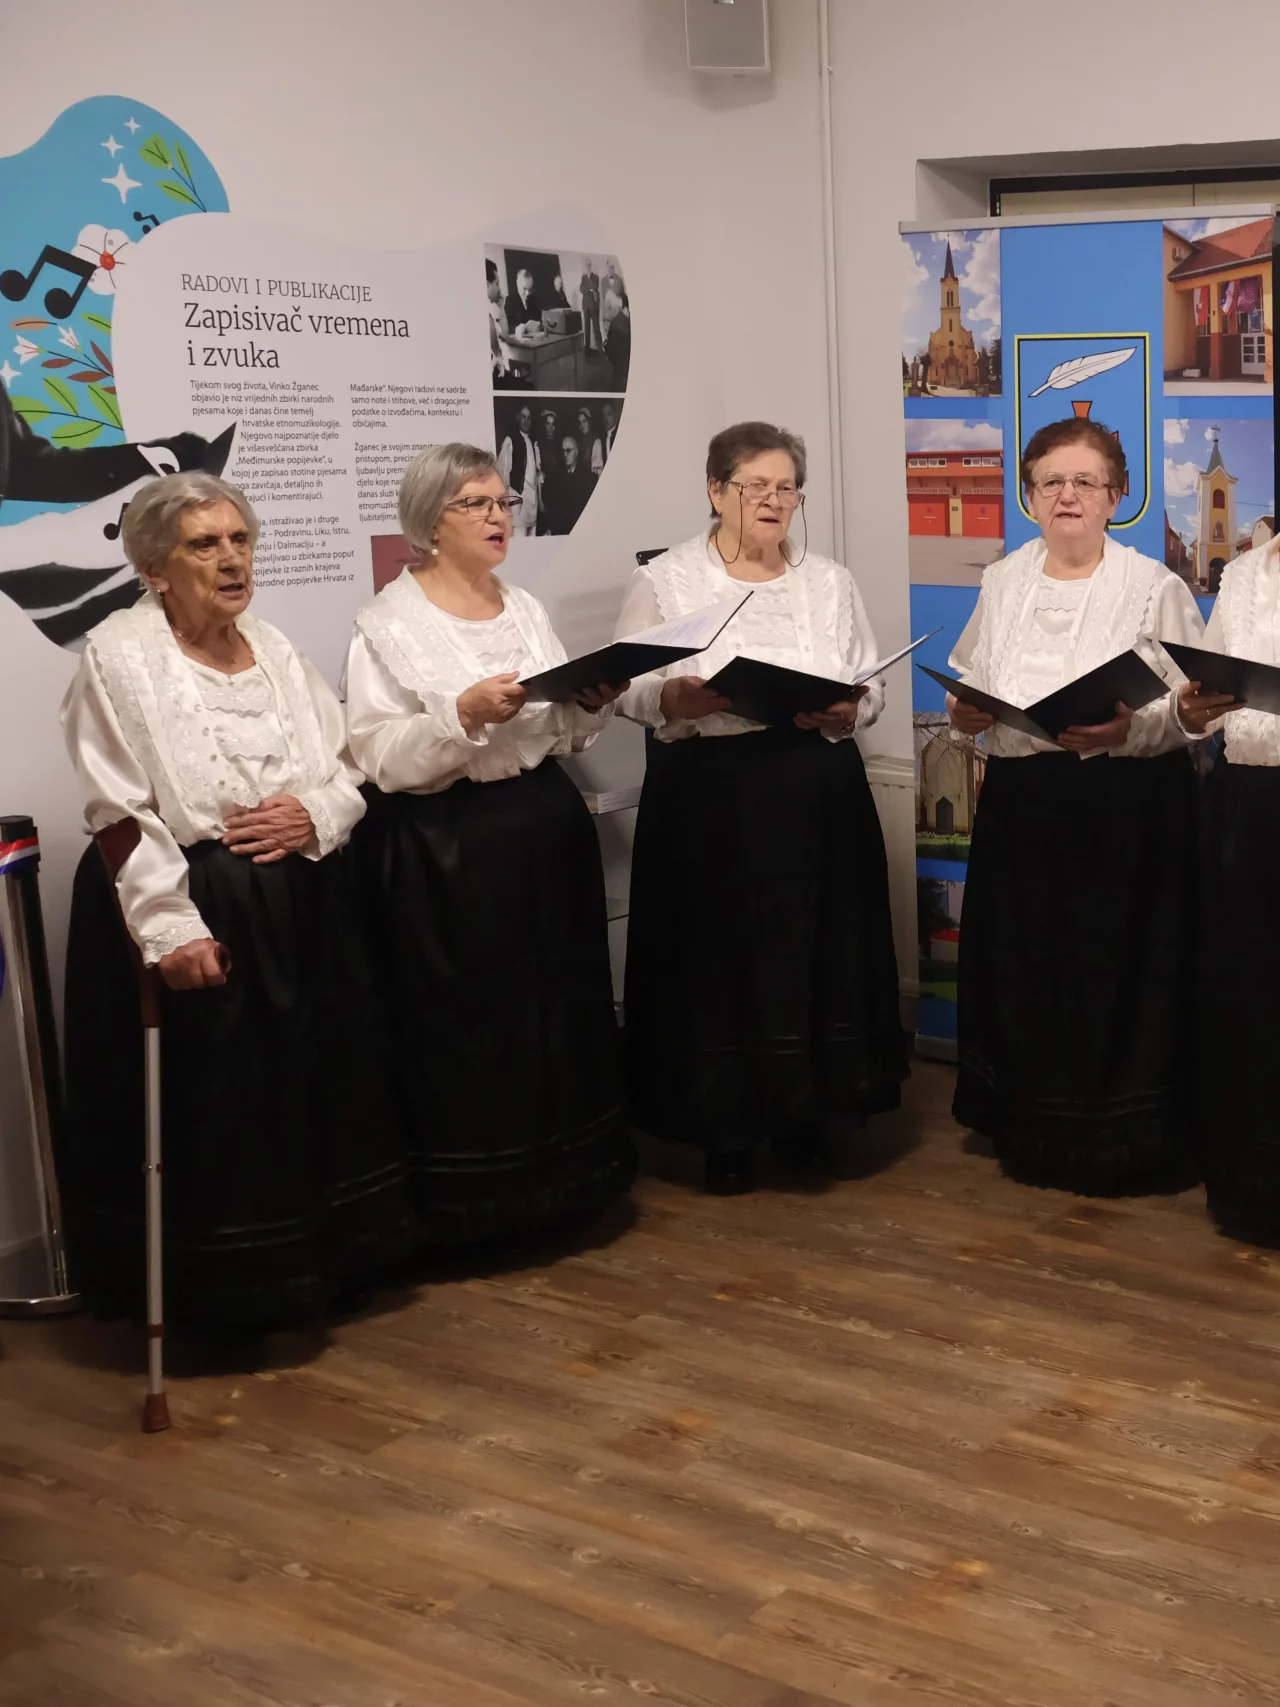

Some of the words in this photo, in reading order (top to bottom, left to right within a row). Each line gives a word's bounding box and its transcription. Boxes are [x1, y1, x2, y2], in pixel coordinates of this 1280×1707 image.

[181, 273, 249, 295] RADOVI
[256, 279, 262, 295] I
[268, 279, 372, 303] PUBLIKACIJE
[184, 302, 302, 336] Zapisivač
[308, 313, 409, 338] vremena
[187, 339, 196, 366] i
[202, 342, 280, 369] zvuka
[190, 380, 221, 389] Tijekom
[224, 382, 241, 391] svog
[244, 381, 268, 390] života,
[269, 382, 290, 390] Vinko
[292, 381, 319, 391] Žganec
[388, 385, 413, 394] Njegovi
[446, 385, 466, 393] sadrže
[192, 394, 220, 404] objavio
[244, 395, 277, 404] vrijednih
[279, 395, 299, 403] zbirki
[301, 395, 334, 403] narodnih
[392, 397, 417, 406] stihove,
[435, 398, 470, 407] dragocjene
[193, 407, 225, 415] pjesama
[227, 407, 243, 415] koje
[249, 407, 271, 415] danas
[274, 407, 288, 415] čine
[291, 407, 314, 416] temelj
[352, 409, 380, 417] podatke
[242, 419, 274, 427] hrvatske
[276, 419, 341, 429] etnomuzikologije.
[240, 432, 273, 441] Njegovo
[274, 431, 319, 441] najpoznatije
[321, 431, 339, 441] djelo
[354, 442, 379, 452] Žganec
[389, 443, 410, 452] svojim
[232, 469, 250, 478] kojoj
[261, 468, 288, 478] zapisao
[290, 468, 315, 476] stotine
[317, 468, 346, 476] pjesama
[356, 466, 385, 475] ljubavlju
[251, 480, 283, 490] zavičaja,
[284, 480, 314, 489] detaljno
[357, 478, 374, 487] djelo
[376, 478, 389, 486] koje
[272, 493, 324, 502] komentirajući.
[379, 490, 394, 498] služi
[270, 516, 304, 525] istraživao
[318, 516, 339, 525] druge
[359, 513, 396, 523] ljubiteljima
[274, 529, 313, 538] Podravinu,
[315, 528, 331, 537] Liku,
[333, 527, 350, 536] Istru,
[278, 541, 314, 551] Dalmaciju
[299, 552, 331, 560] zbirkama
[333, 551, 354, 560] poput
[291, 564, 313, 573] raznih
[315, 563, 340, 572] krajeva
[287, 577, 322, 587] popijevke
[324, 574, 346, 582] Hrvata
